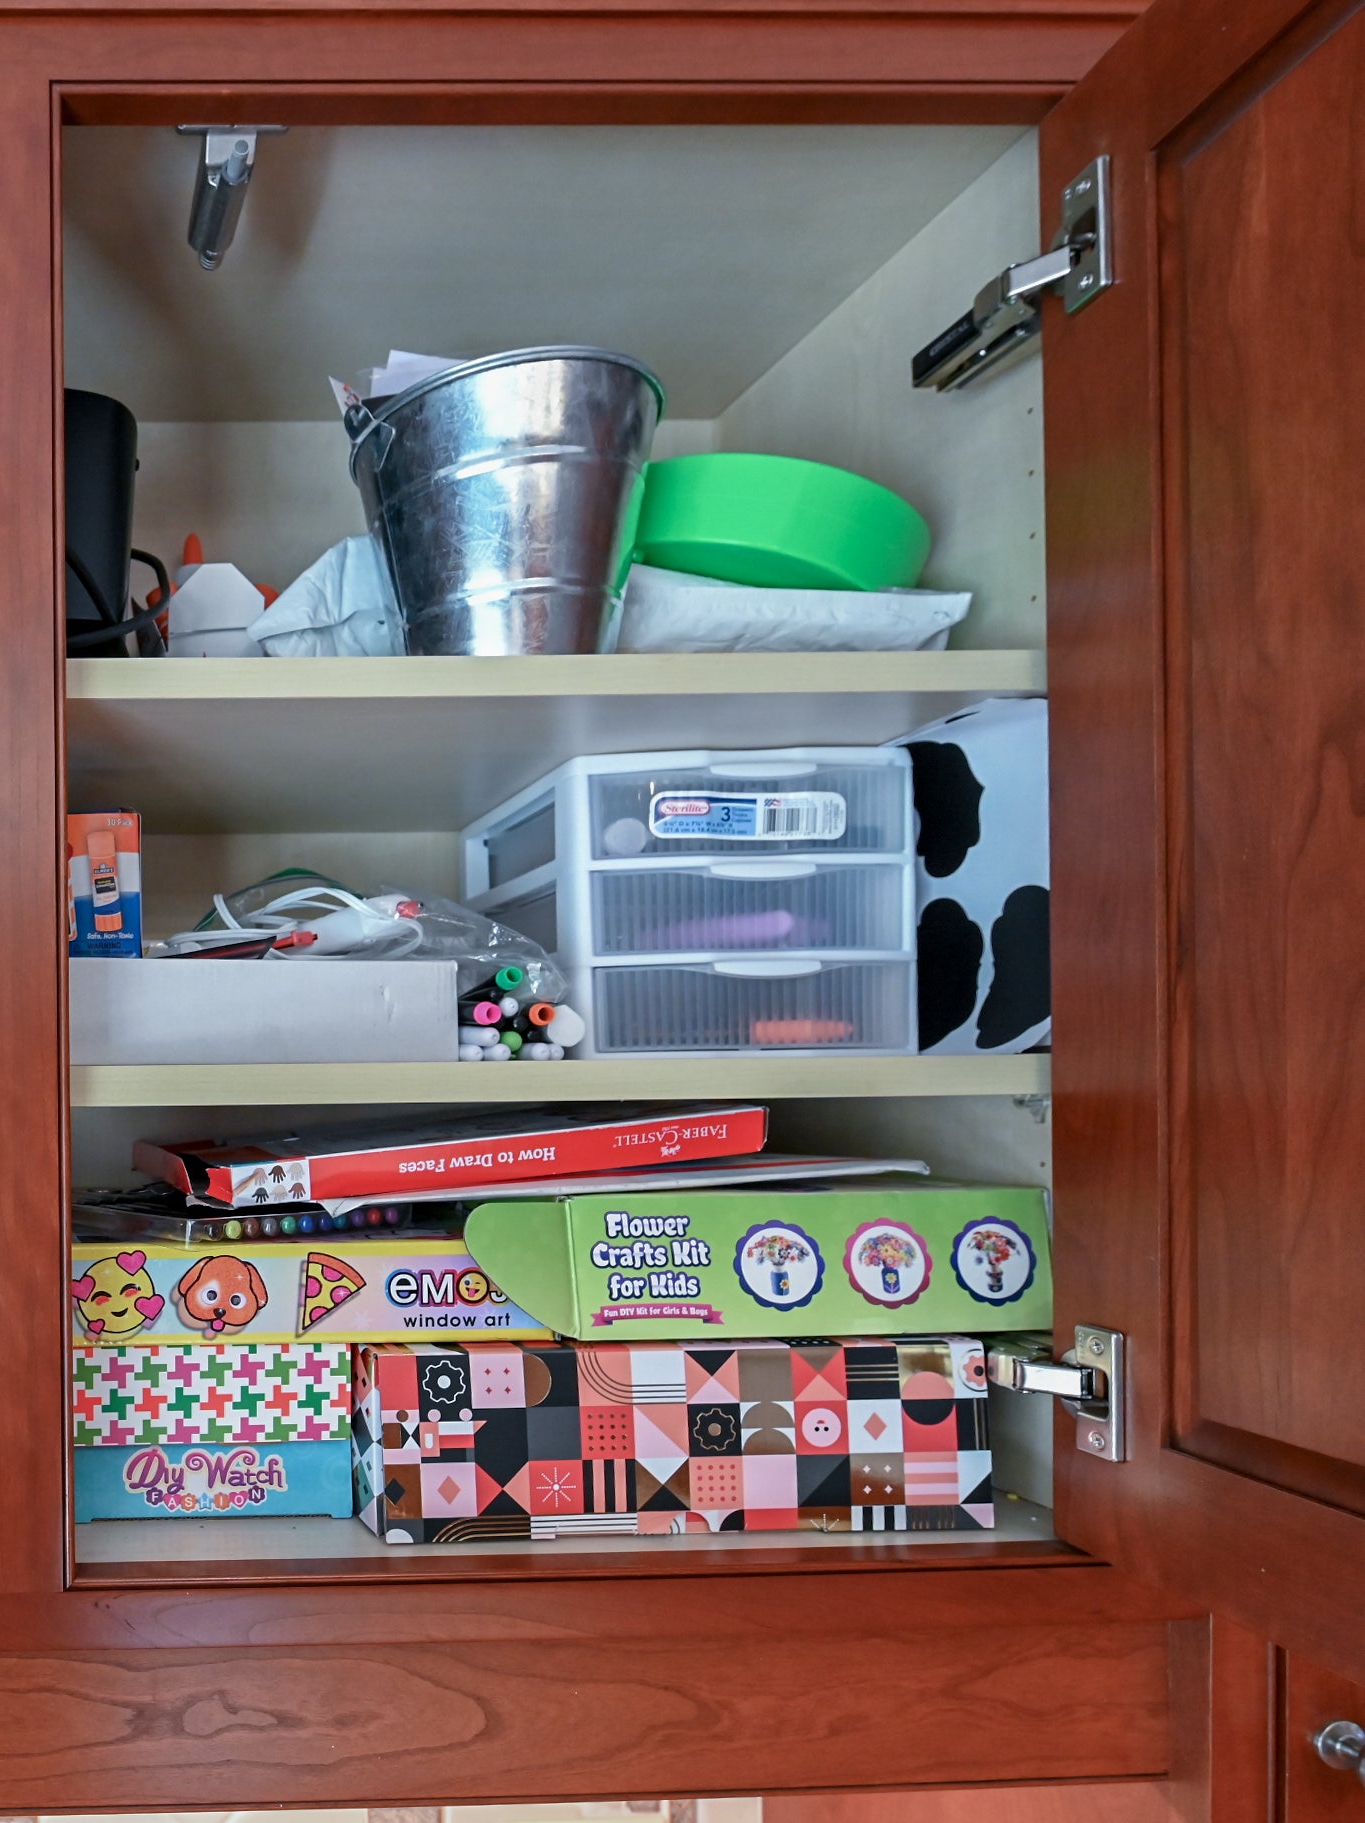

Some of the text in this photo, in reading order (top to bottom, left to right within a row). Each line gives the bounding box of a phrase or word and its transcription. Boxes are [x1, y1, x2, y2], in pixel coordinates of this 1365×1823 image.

[664, 802, 704, 814] Sterilite
[721, 806, 730, 822] 3
[614, 1124, 728, 1147] FABER-CASTELL
[398, 1145, 555, 1176] How to Draw Faces
[606, 1213, 688, 1237] Flower
[592, 1240, 710, 1268] Crafts Kit
[610, 1272, 699, 1299] for Kids
[404, 1313, 510, 1327] window art
[604, 1306, 708, 1317] Fun DIY Kit for Girls & Boys
[185, 1450, 283, 1489] Watch
[150, 1487, 262, 1509] FASHION
